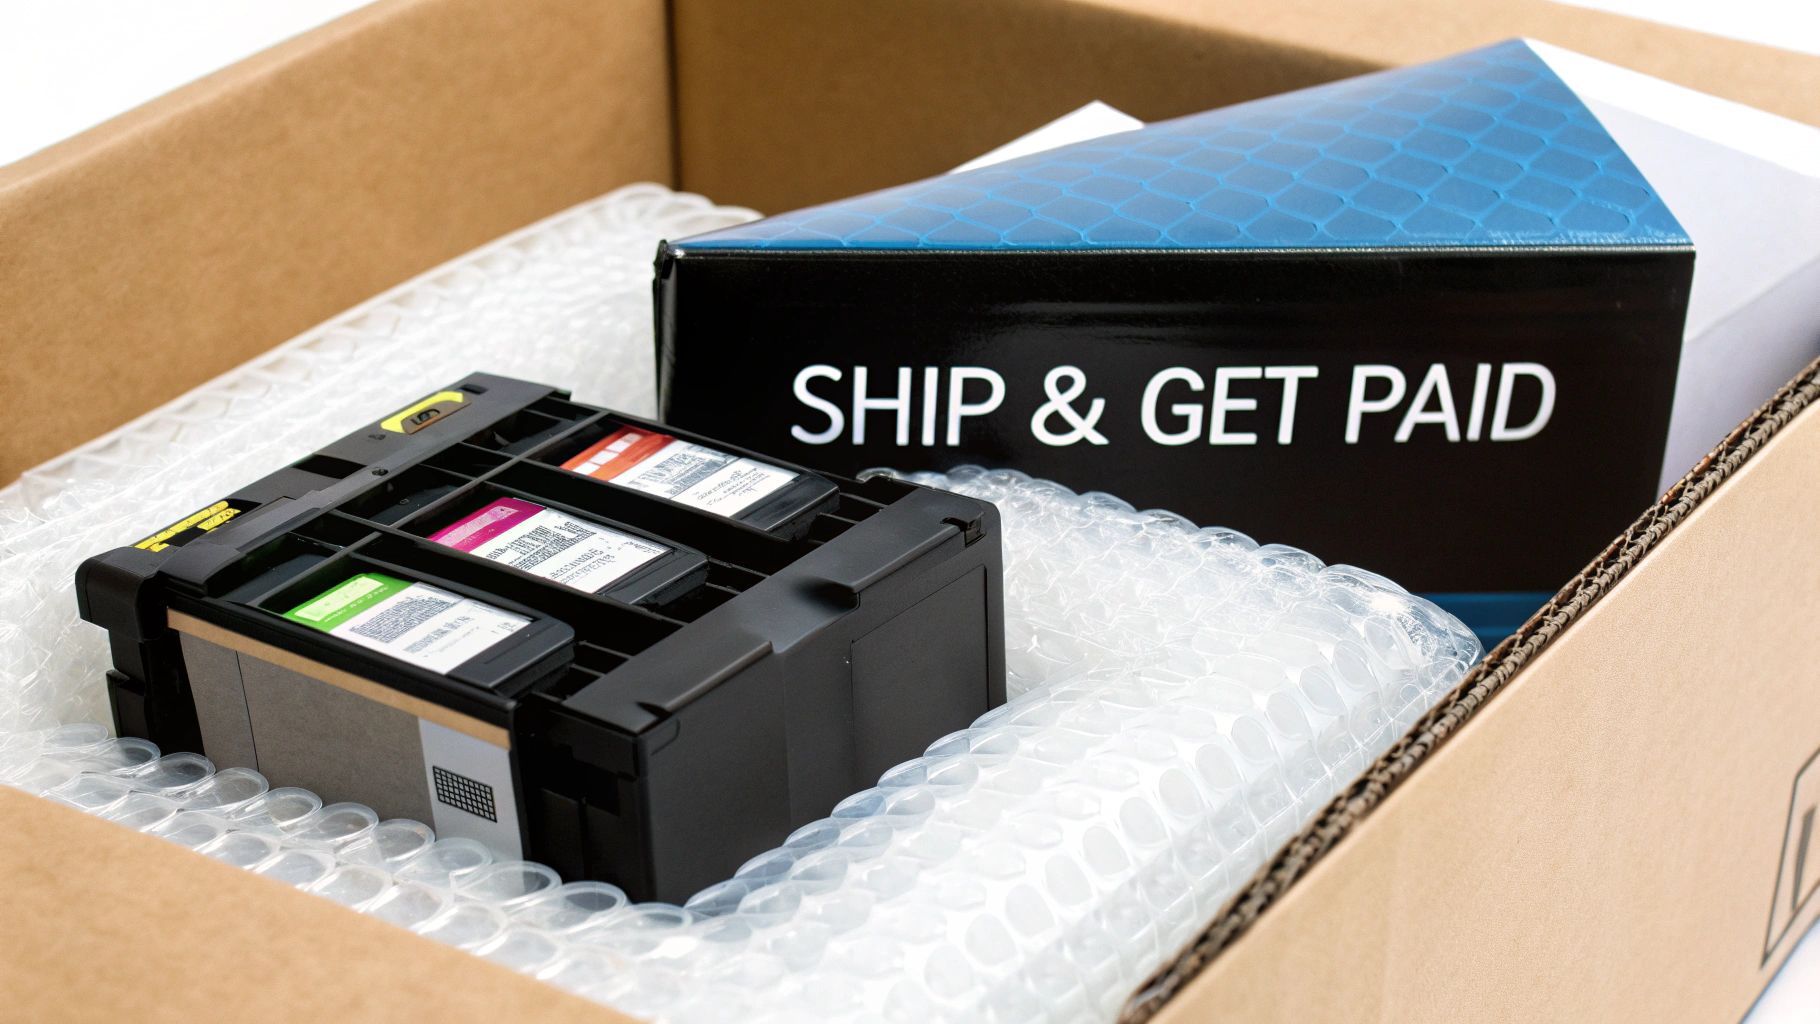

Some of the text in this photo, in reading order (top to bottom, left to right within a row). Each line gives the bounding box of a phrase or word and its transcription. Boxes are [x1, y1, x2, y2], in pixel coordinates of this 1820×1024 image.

[791, 362, 1556, 447] SHIP & GET PAID
